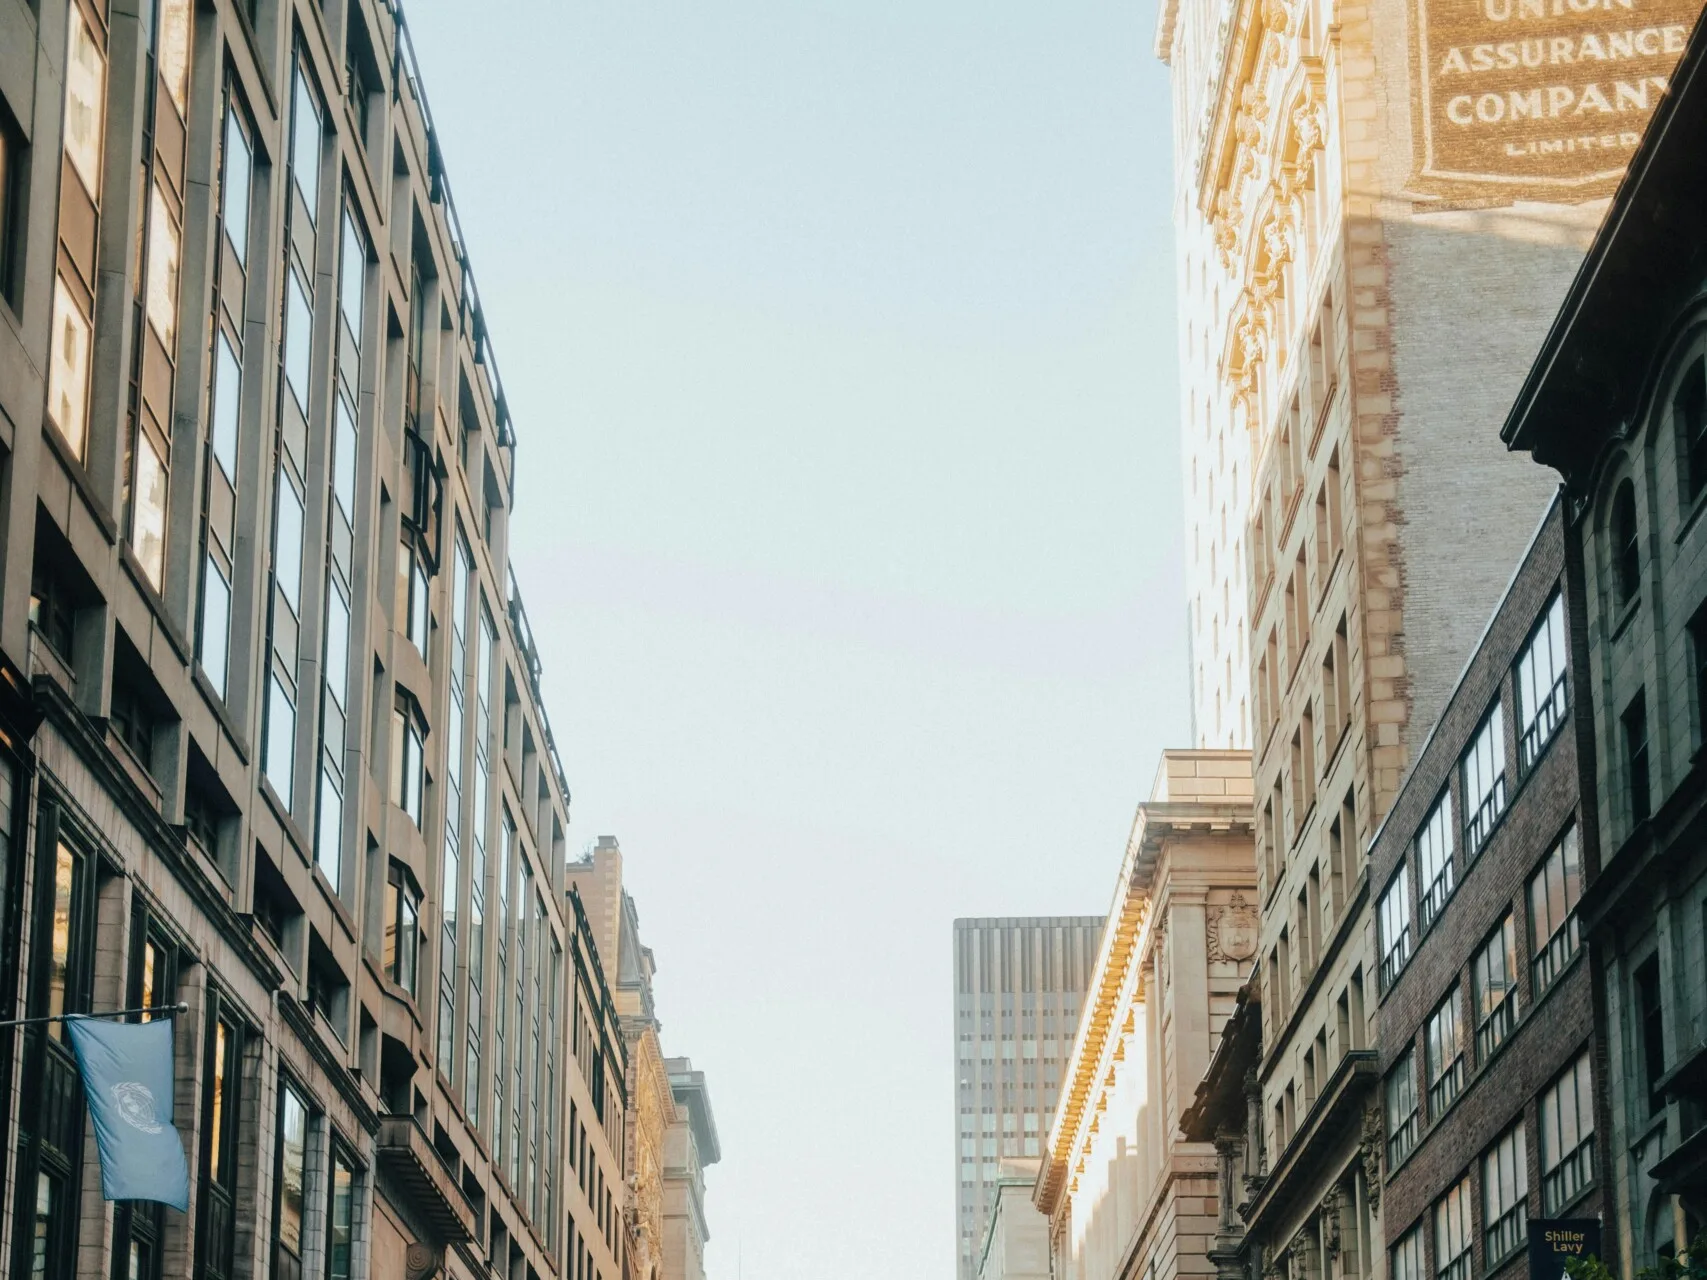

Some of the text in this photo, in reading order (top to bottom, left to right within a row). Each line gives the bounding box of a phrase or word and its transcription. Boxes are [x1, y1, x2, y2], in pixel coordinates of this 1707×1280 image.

[1440, 25, 1687, 75] ASSURANCE
[1505, 132, 1640, 157] LIMITED
[1545, 1230, 1585, 1242] Shiller
[1553, 1242, 1583, 1254] Lavy
